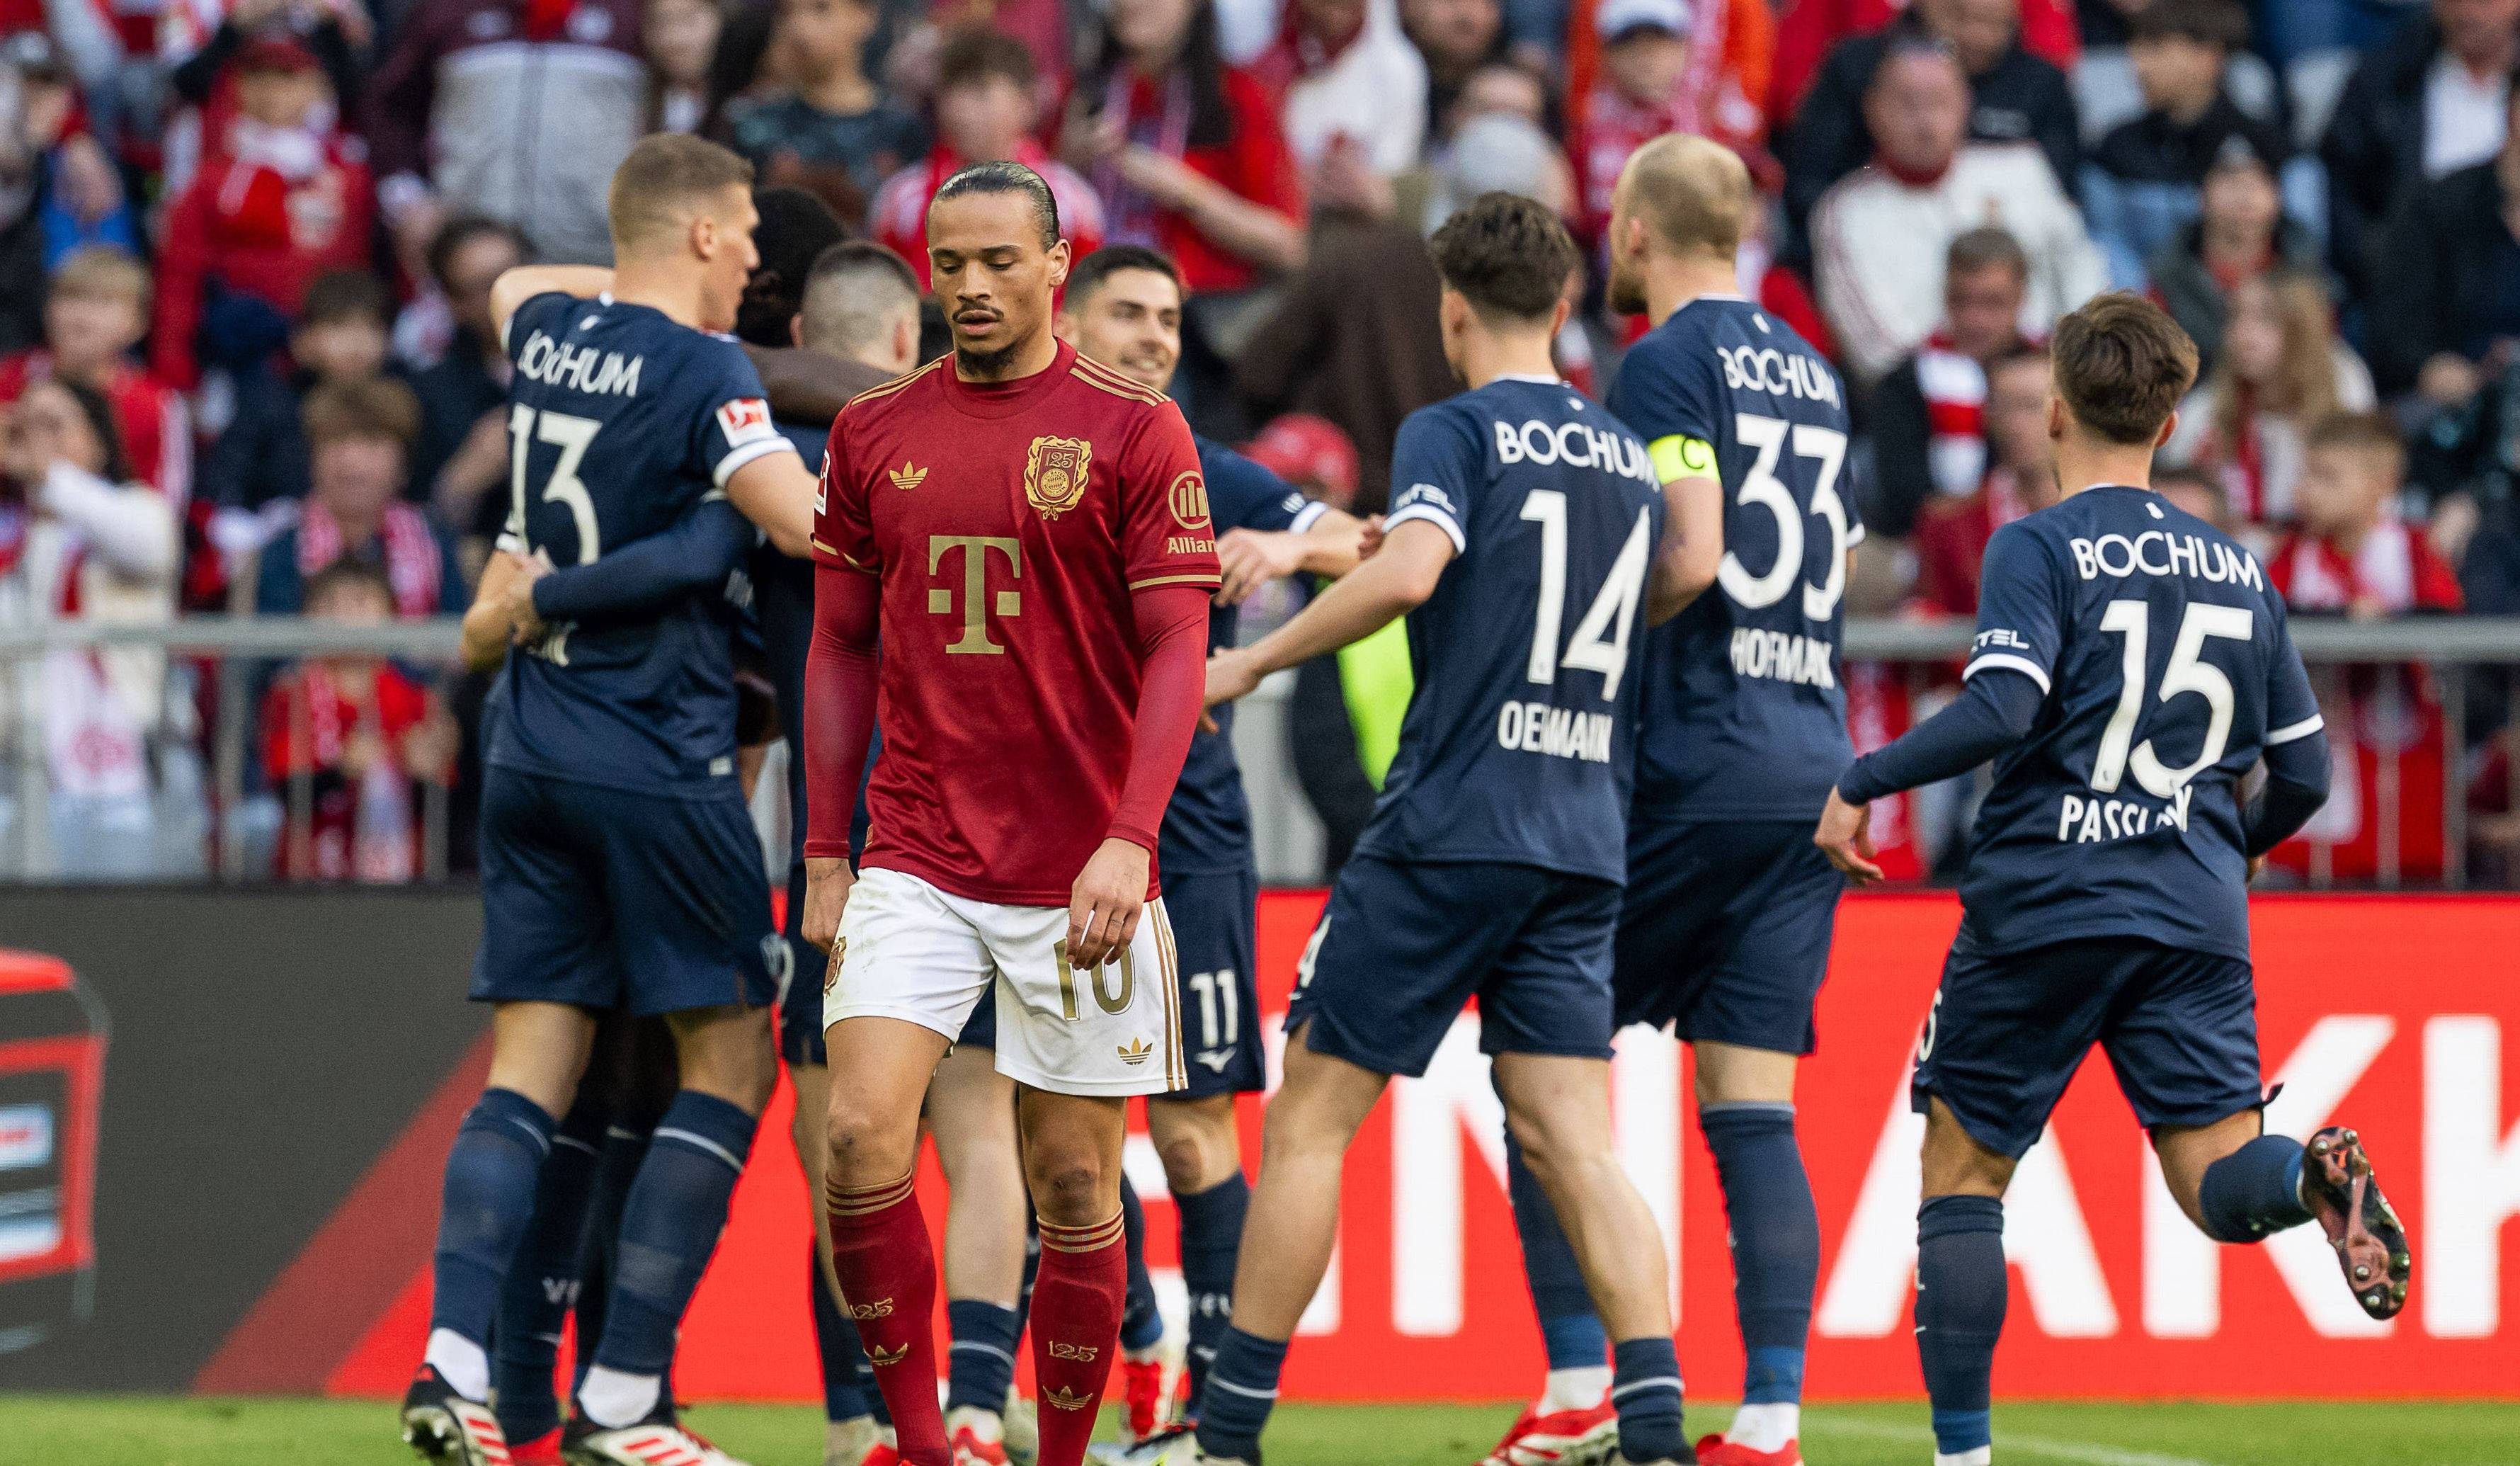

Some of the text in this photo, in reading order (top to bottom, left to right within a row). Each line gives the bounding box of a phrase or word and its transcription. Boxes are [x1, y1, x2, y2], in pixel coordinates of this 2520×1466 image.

[508, 401, 603, 572] 13
[1681, 436, 1706, 470] C
[1717, 412, 1848, 621] 33
[929, 535, 1021, 654] T
[1519, 489, 1650, 702] 14
[2069, 530, 2264, 592] BOCHUM
[2089, 599, 2254, 799] 15
[1054, 938, 1136, 1021] 10
[1190, 969, 1239, 1048] 11
[850, 1297, 894, 1319] 125
[1048, 1341, 1098, 1362] 125
